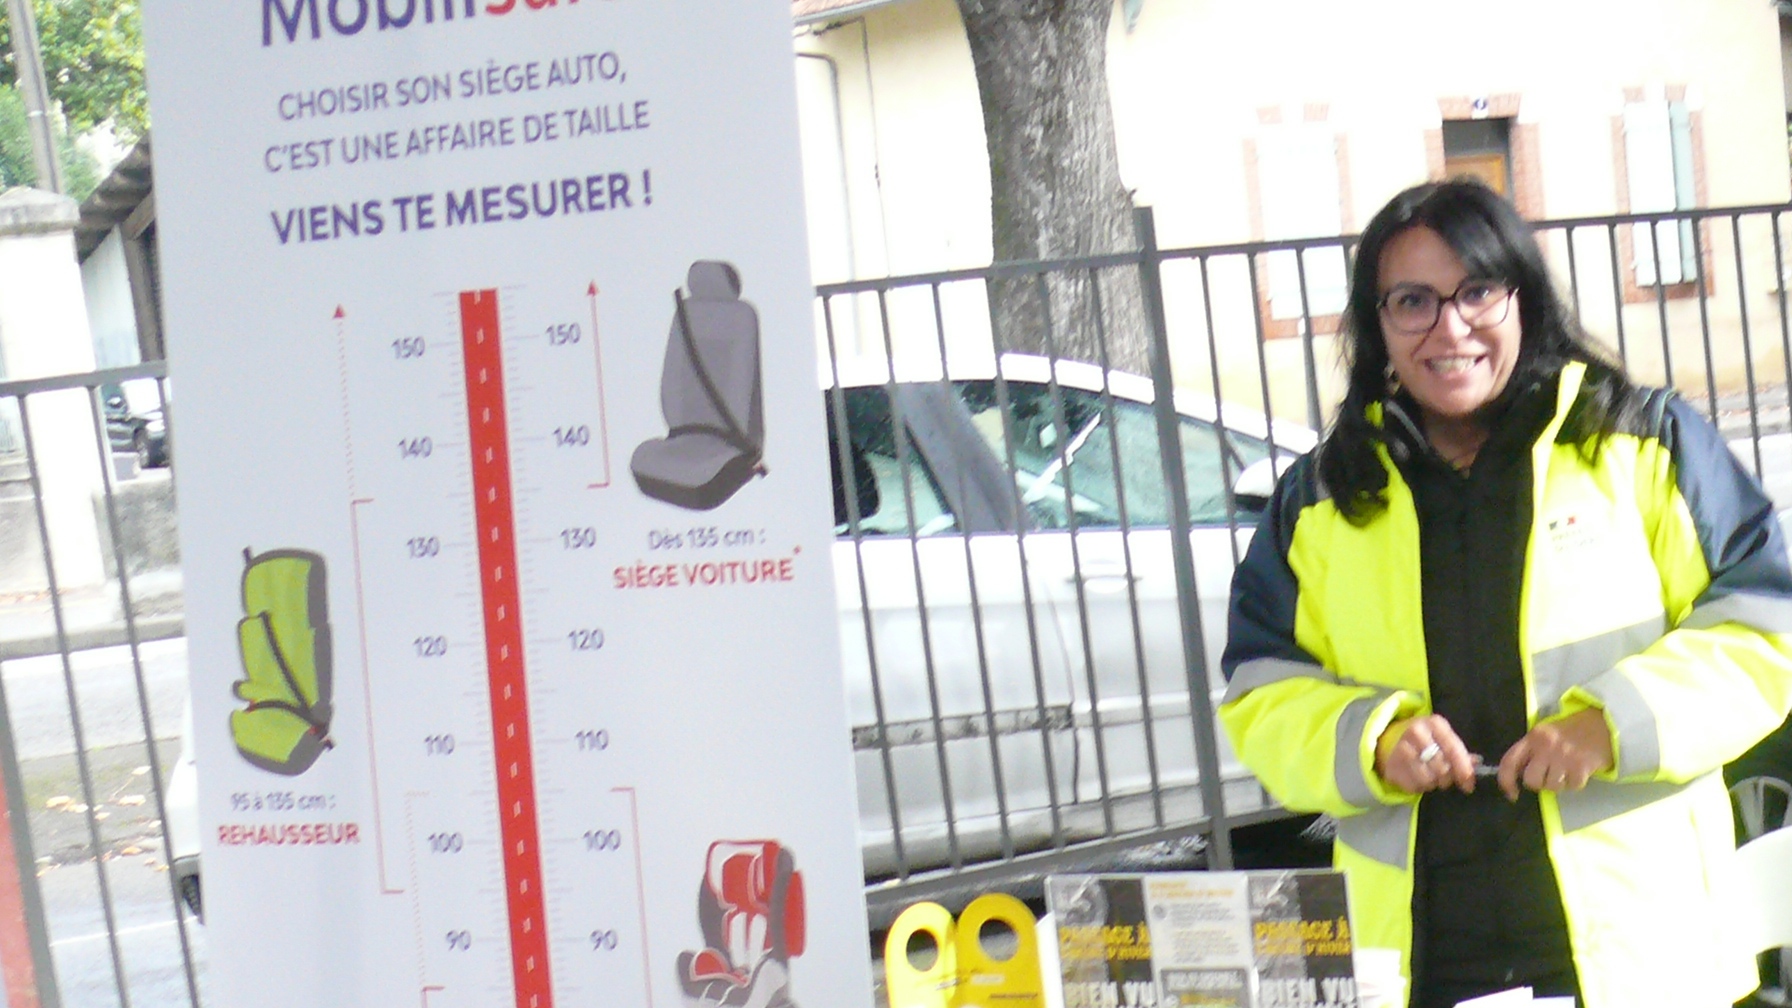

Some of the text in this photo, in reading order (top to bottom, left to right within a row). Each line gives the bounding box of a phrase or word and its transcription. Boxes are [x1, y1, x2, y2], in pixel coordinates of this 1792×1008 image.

[278, 51, 627, 120] CHOISIR SON SIÈGE AUTO,
[265, 101, 651, 172] C'EST UNE AFFAIRE DE TAILLE
[271, 168, 653, 244] VIENS TE MESURER !
[545, 322, 581, 346] 150
[391, 336, 425, 359] 150
[553, 425, 590, 447] 140
[398, 436, 432, 459] 140
[407, 536, 440, 559] 130
[560, 527, 596, 549] 130
[724, 529, 754, 545] cm
[613, 560, 679, 588] SIÈGE
[413, 634, 447, 658] 120
[568, 628, 604, 651] 120
[424, 734, 454, 756] 110
[575, 730, 609, 752] 110
[218, 823, 361, 845] REHAUSSEUR
[427, 833, 463, 854] 100
[583, 830, 621, 851] 100
[445, 930, 472, 950] 90
[589, 930, 618, 950] 90
